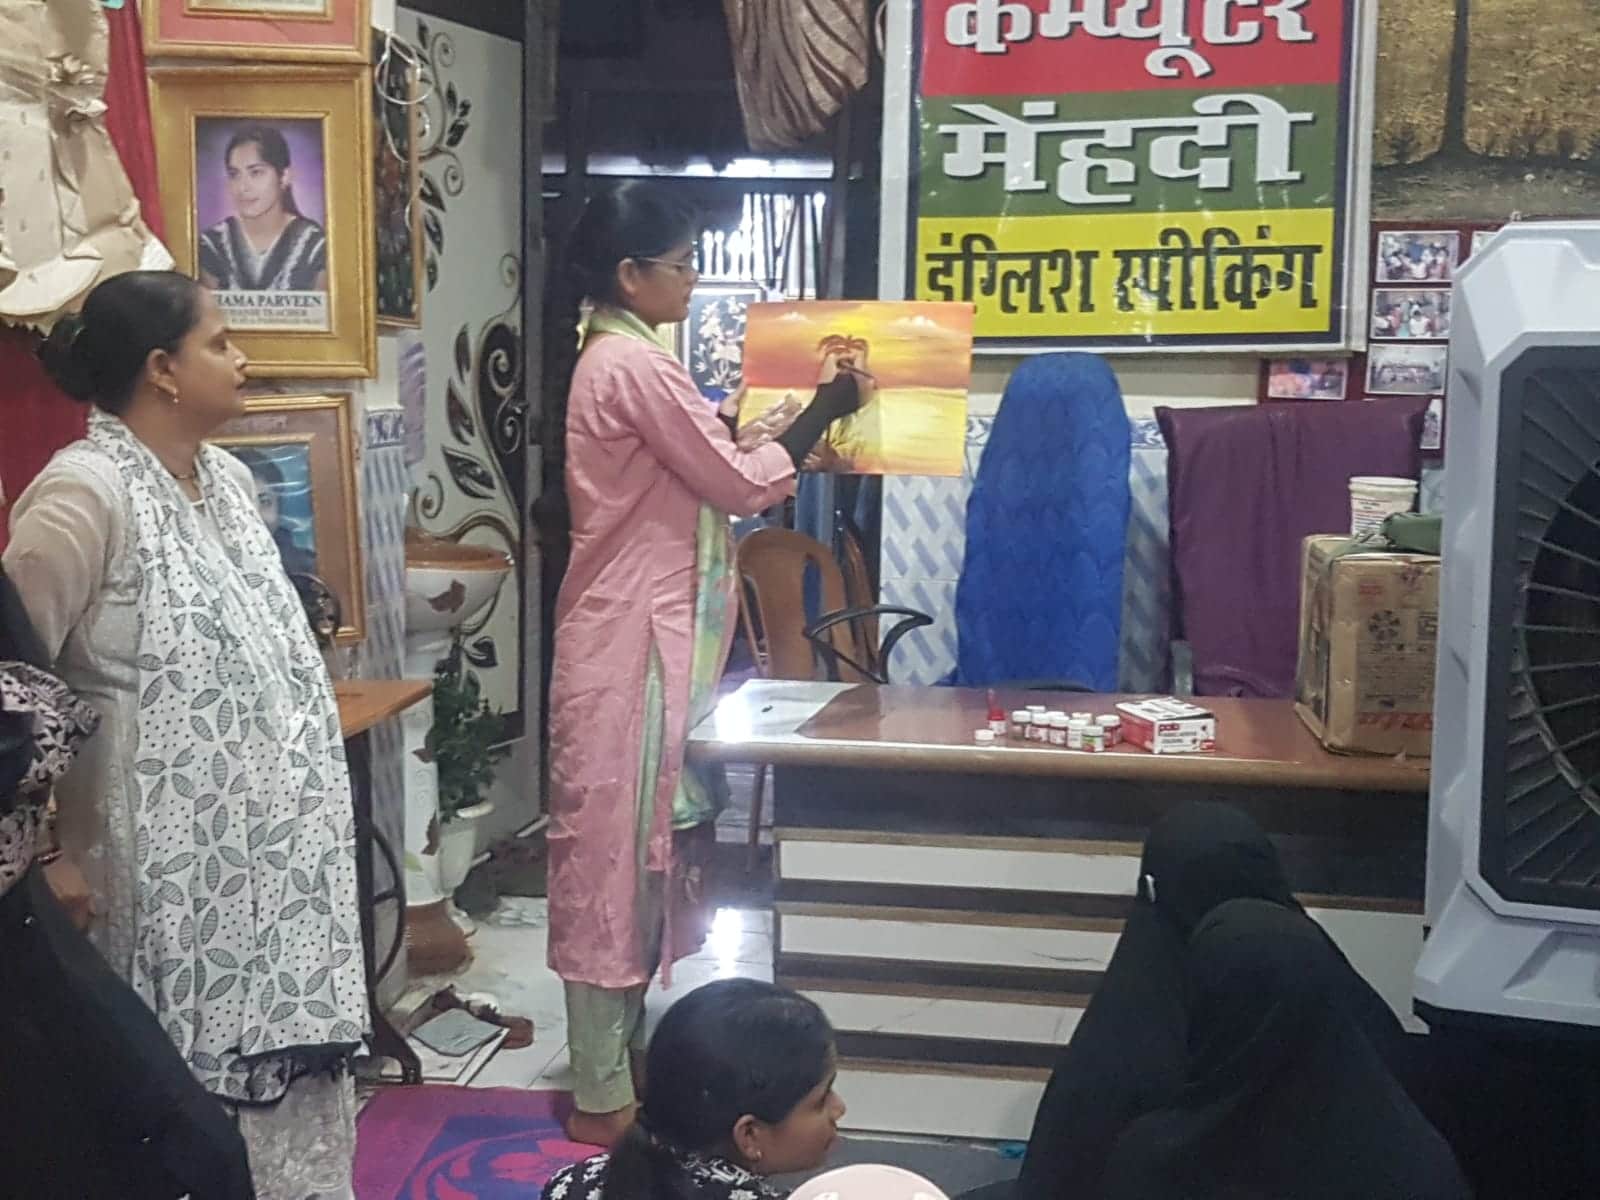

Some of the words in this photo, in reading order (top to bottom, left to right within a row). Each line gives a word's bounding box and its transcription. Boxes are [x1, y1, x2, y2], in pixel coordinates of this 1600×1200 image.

[938, 93, 1314, 204] मेंहदी
[258, 294, 322, 306] PARVEEN
[1113, 225, 1322, 311] स्पीकिंग
